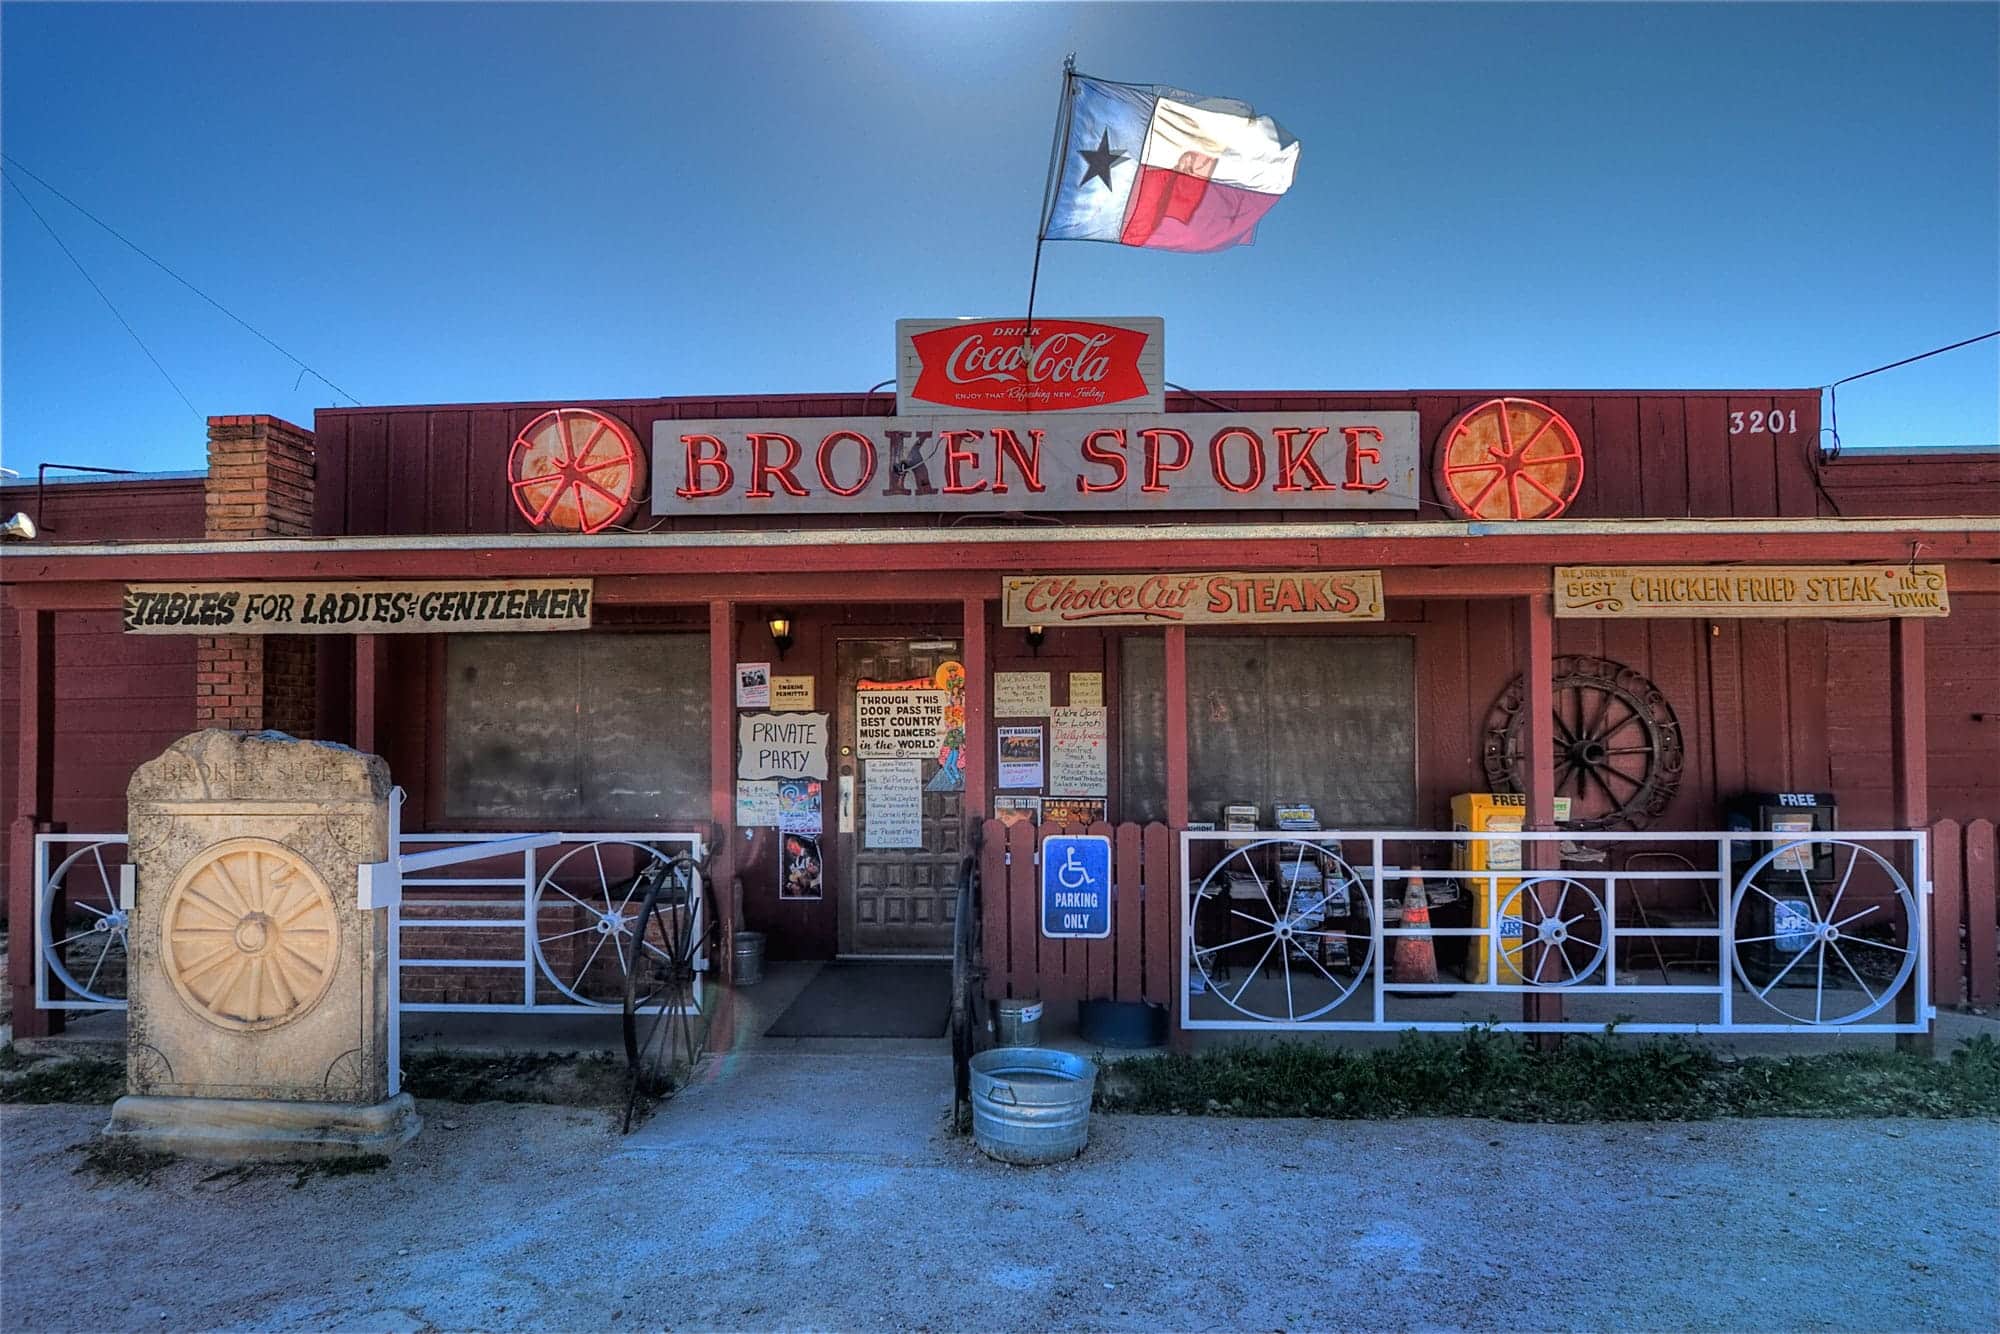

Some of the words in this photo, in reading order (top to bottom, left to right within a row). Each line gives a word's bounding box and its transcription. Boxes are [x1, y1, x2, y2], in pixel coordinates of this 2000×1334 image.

[945, 332, 1115, 384] CocaCola
[955, 392, 983, 400] ENJOY
[1007, 386, 1051, 402] Refreshing
[1073, 386, 1105, 401] Feeling
[1729, 409, 1797, 435] 3201
[675, 428, 1047, 498] BROKEN
[1076, 425, 1389, 494] SPOKE
[1567, 581, 1617, 597] BEST
[1630, 576, 1732, 602] CHICKEN
[1737, 575, 1797, 602] FRIED
[1806, 575, 1887, 602] STEAK
[1900, 576, 1918, 589] IN
[1024, 577, 1132, 614] Choice
[1136, 576, 1202, 609] Cut
[1206, 577, 1361, 614] STEAKS
[1889, 592, 1939, 608] TOWN
[131, 592, 241, 626] TABLES
[243, 593, 295, 624] FOR
[300, 592, 413, 624] LADIES
[419, 588, 590, 622] GENTLEMEN
[860, 696, 909, 704] THROUGH
[916, 696, 939, 704] THIS
[861, 706, 891, 715] DOOR
[897, 706, 922, 715] PASS
[925, 705, 942, 714] THE
[1080, 707, 1102, 720] Open
[860, 717, 887, 727] BEST
[890, 716, 942, 726] COUNTRY
[1056, 718, 1068, 728] for
[1071, 718, 1102, 728] Lunch
[752, 722, 817, 745] PRIVATE
[860, 729, 891, 738] MUSIC
[893, 728, 937, 738] DANCERS
[1000, 728, 1013, 736] TONY
[860, 740, 871, 750] in
[875, 740, 893, 750] the
[161, 762, 264, 783] BROKEN
[277, 760, 353, 785] SPOKE
[1492, 795, 1526, 806] FREE
[1779, 794, 1817, 806] FREE
[1055, 893, 1098, 908] PARKING
[1064, 913, 1089, 929] ONLY
